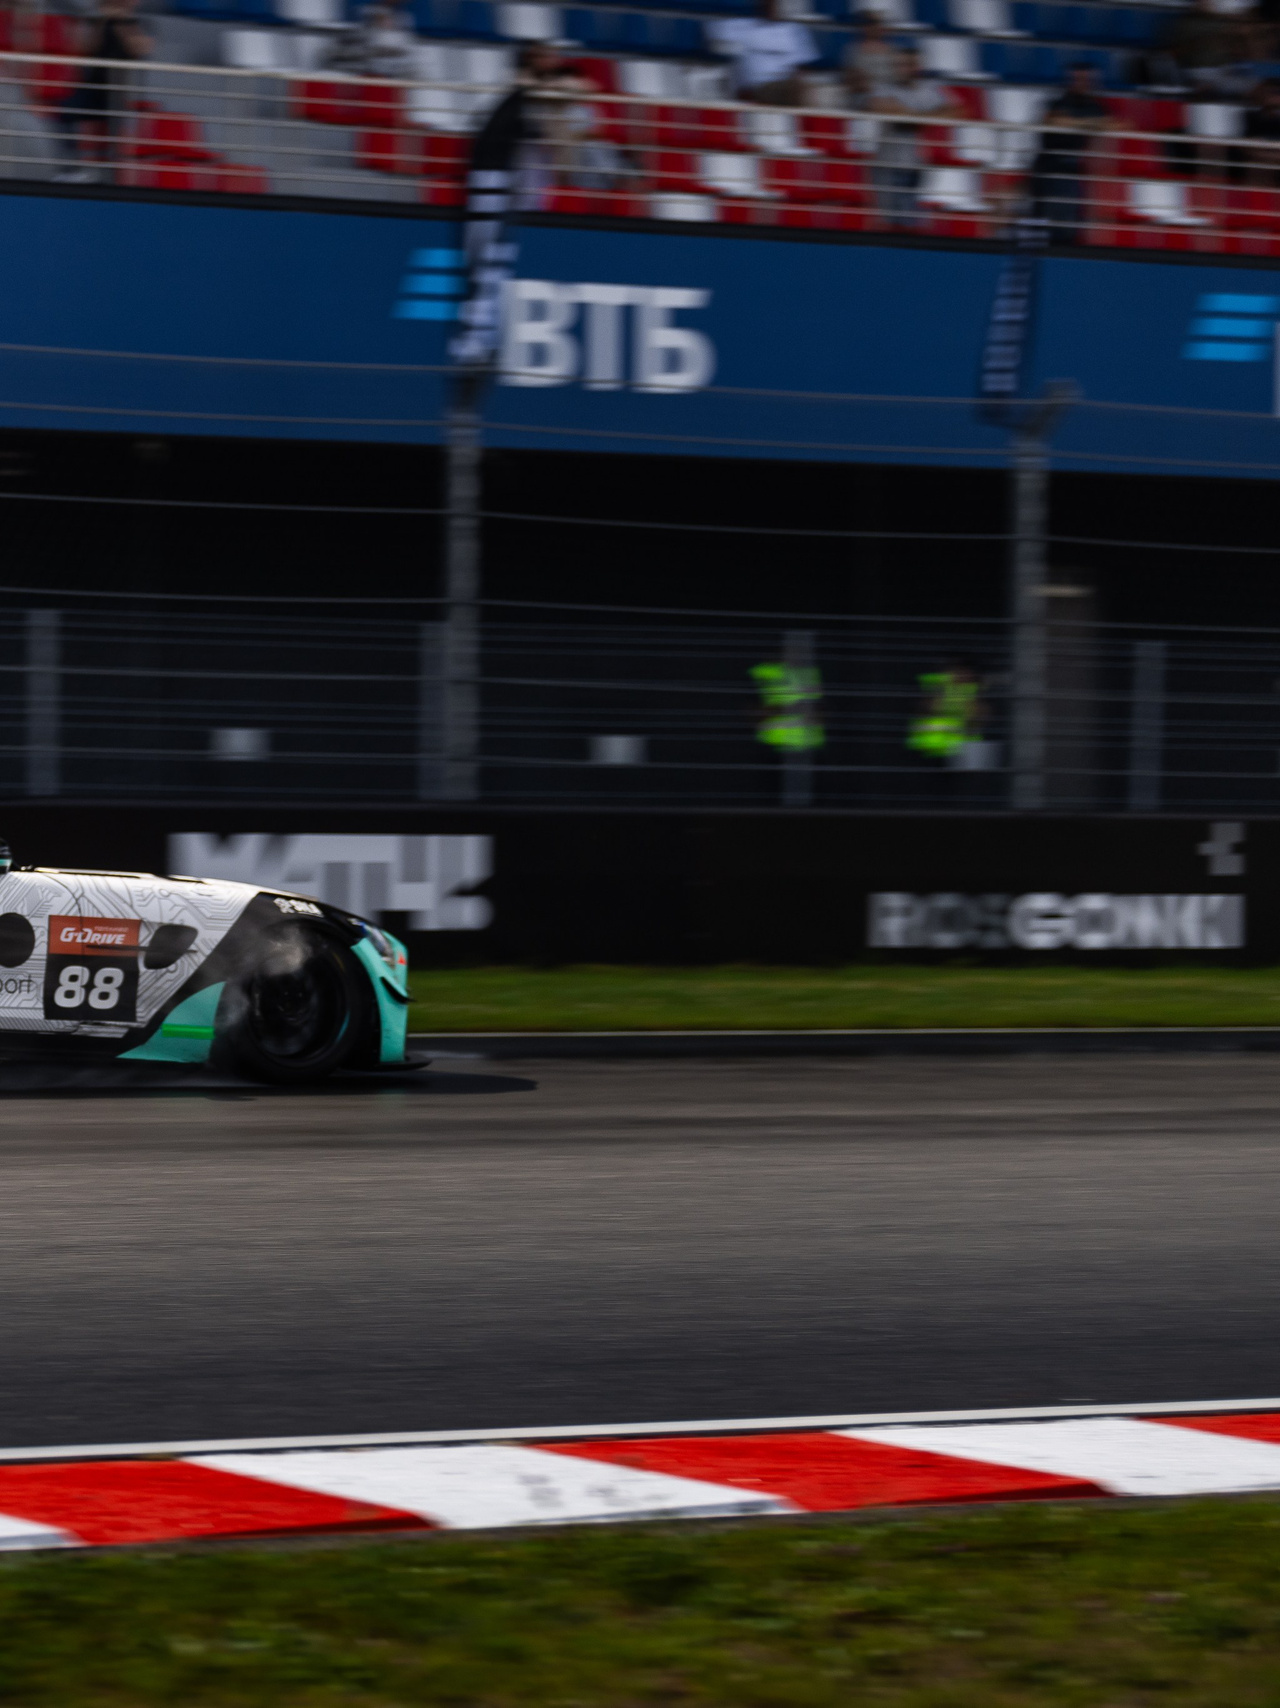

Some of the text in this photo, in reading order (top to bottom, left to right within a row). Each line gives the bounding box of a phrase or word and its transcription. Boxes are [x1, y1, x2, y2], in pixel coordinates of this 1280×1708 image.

[495, 279, 718, 393] ВТБ
[868, 893, 1246, 949] ROSGONKI
[54, 965, 124, 1009] 88
